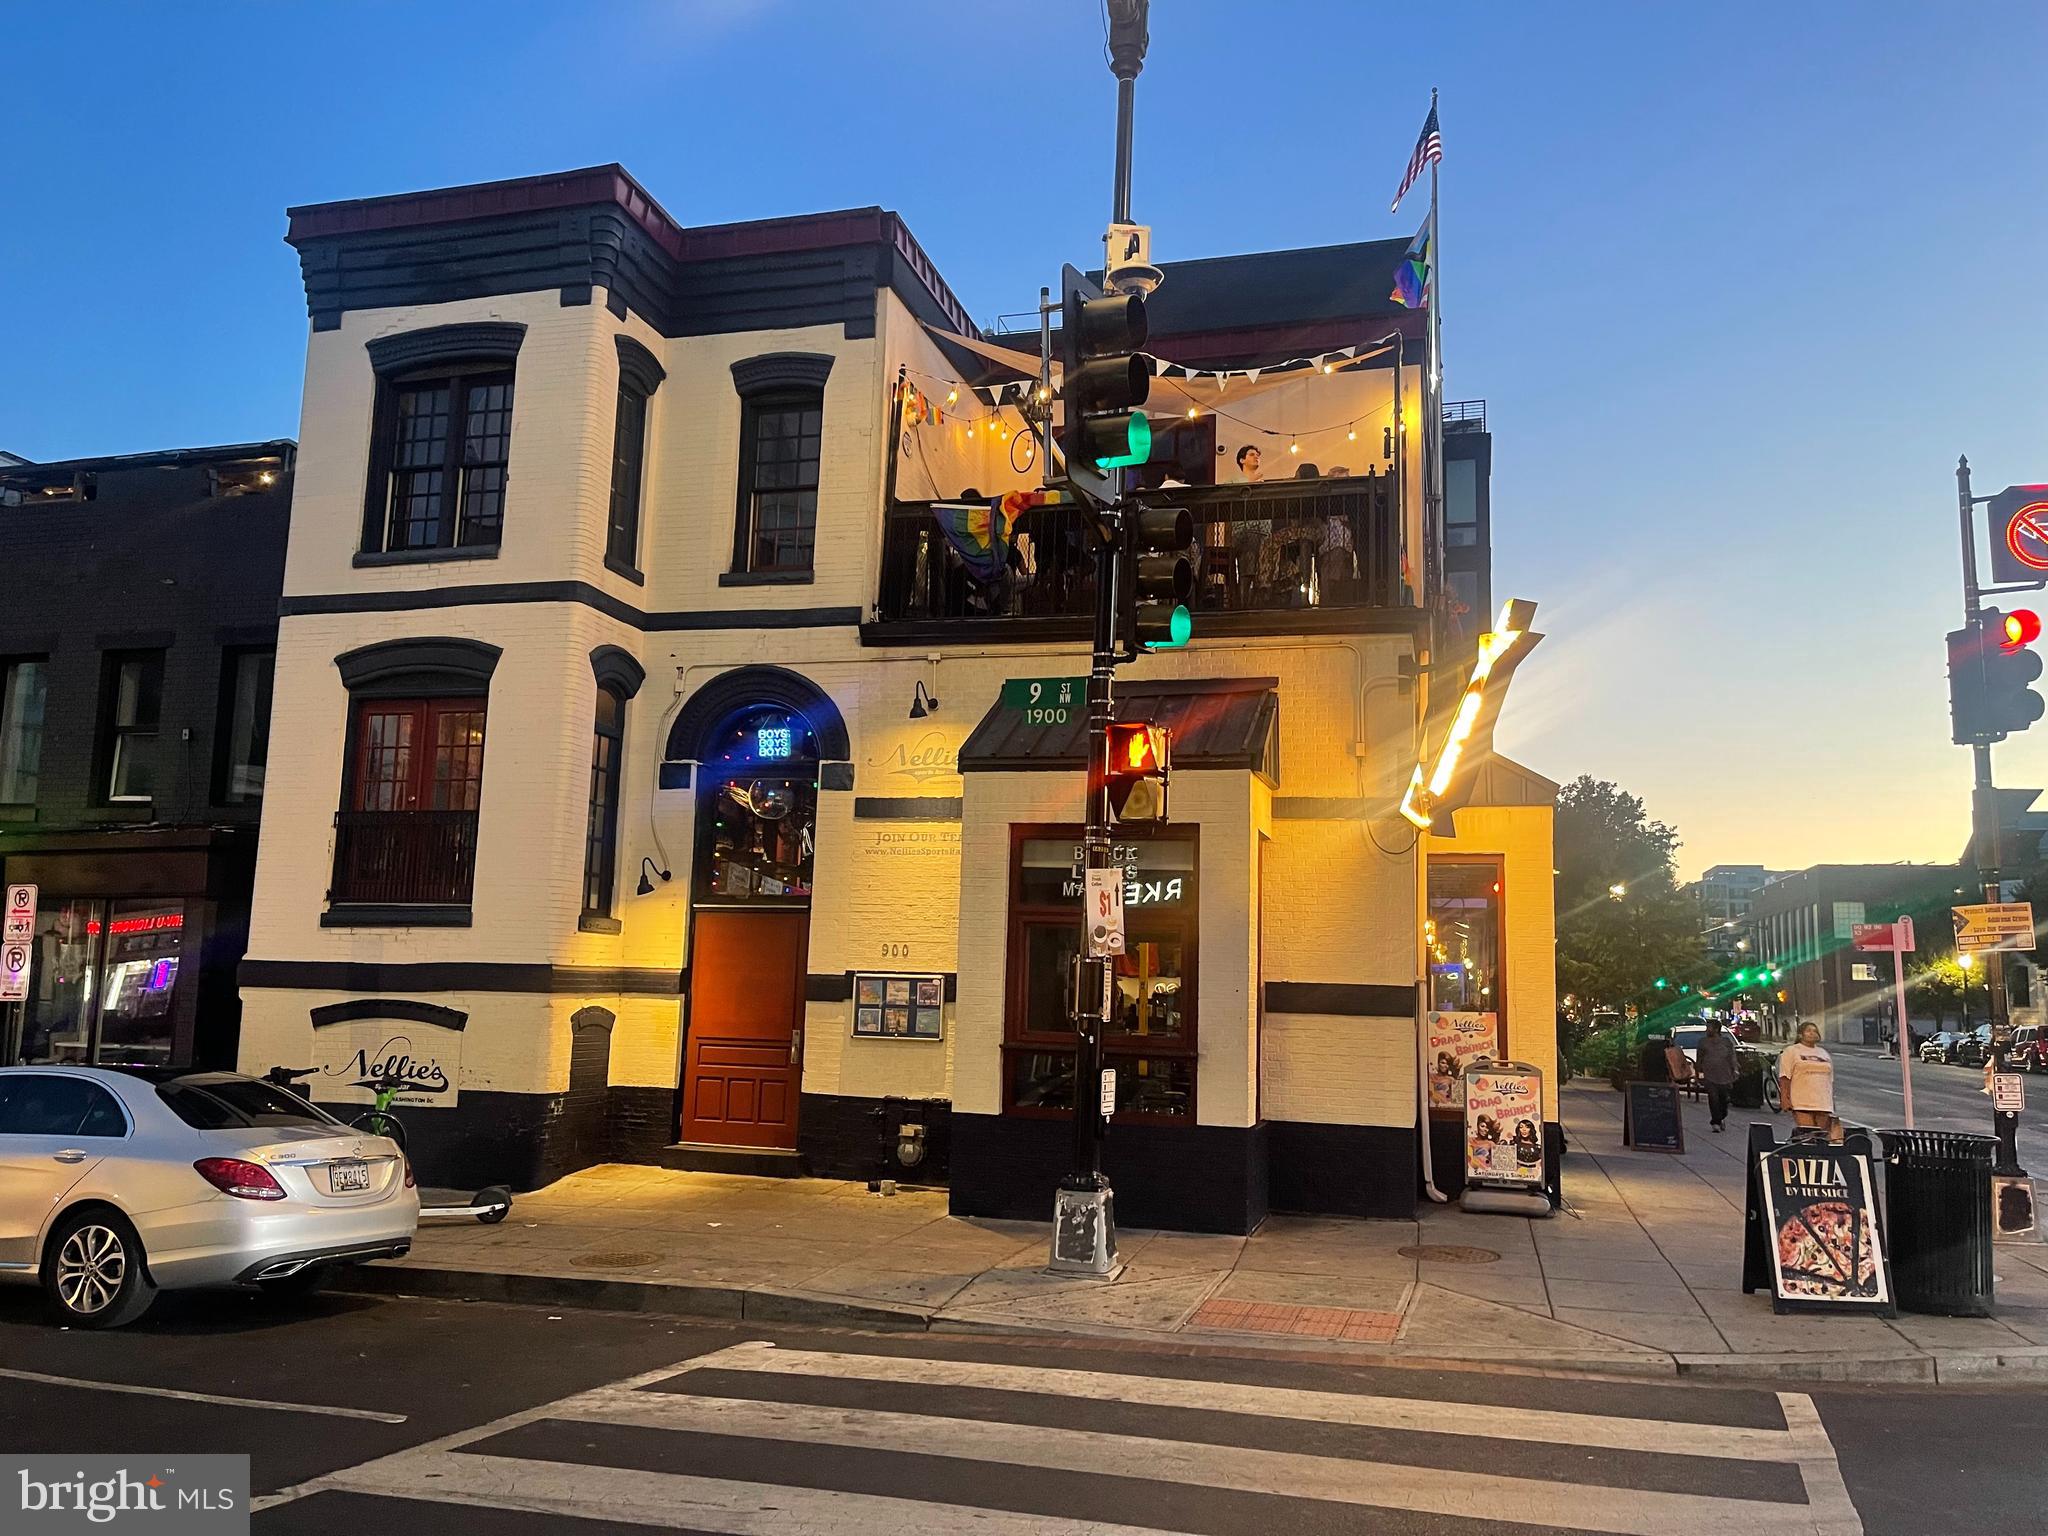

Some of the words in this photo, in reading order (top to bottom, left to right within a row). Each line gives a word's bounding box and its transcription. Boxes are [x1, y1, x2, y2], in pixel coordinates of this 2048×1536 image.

[1030, 683, 1042, 704] 9
[1061, 683, 1071, 694] ST
[1060, 693, 1071, 704] NW
[1027, 709, 1067, 724] 1900
[758, 729, 789, 739] BOYS
[759, 739, 789, 748] BOYS
[759, 747, 789, 757] BOYS
[1073, 845, 1139, 861] BCK
[1099, 889, 1112, 918] $1
[881, 943, 909, 958] 900
[323, 1036, 449, 1080] Nellie's
[1781, 1157, 1847, 1186] PIZZA
[1785, 1186, 1799, 1196] BY
[1801, 1187, 1819, 1197] THE
[1821, 1188, 1849, 1199] SLICE
